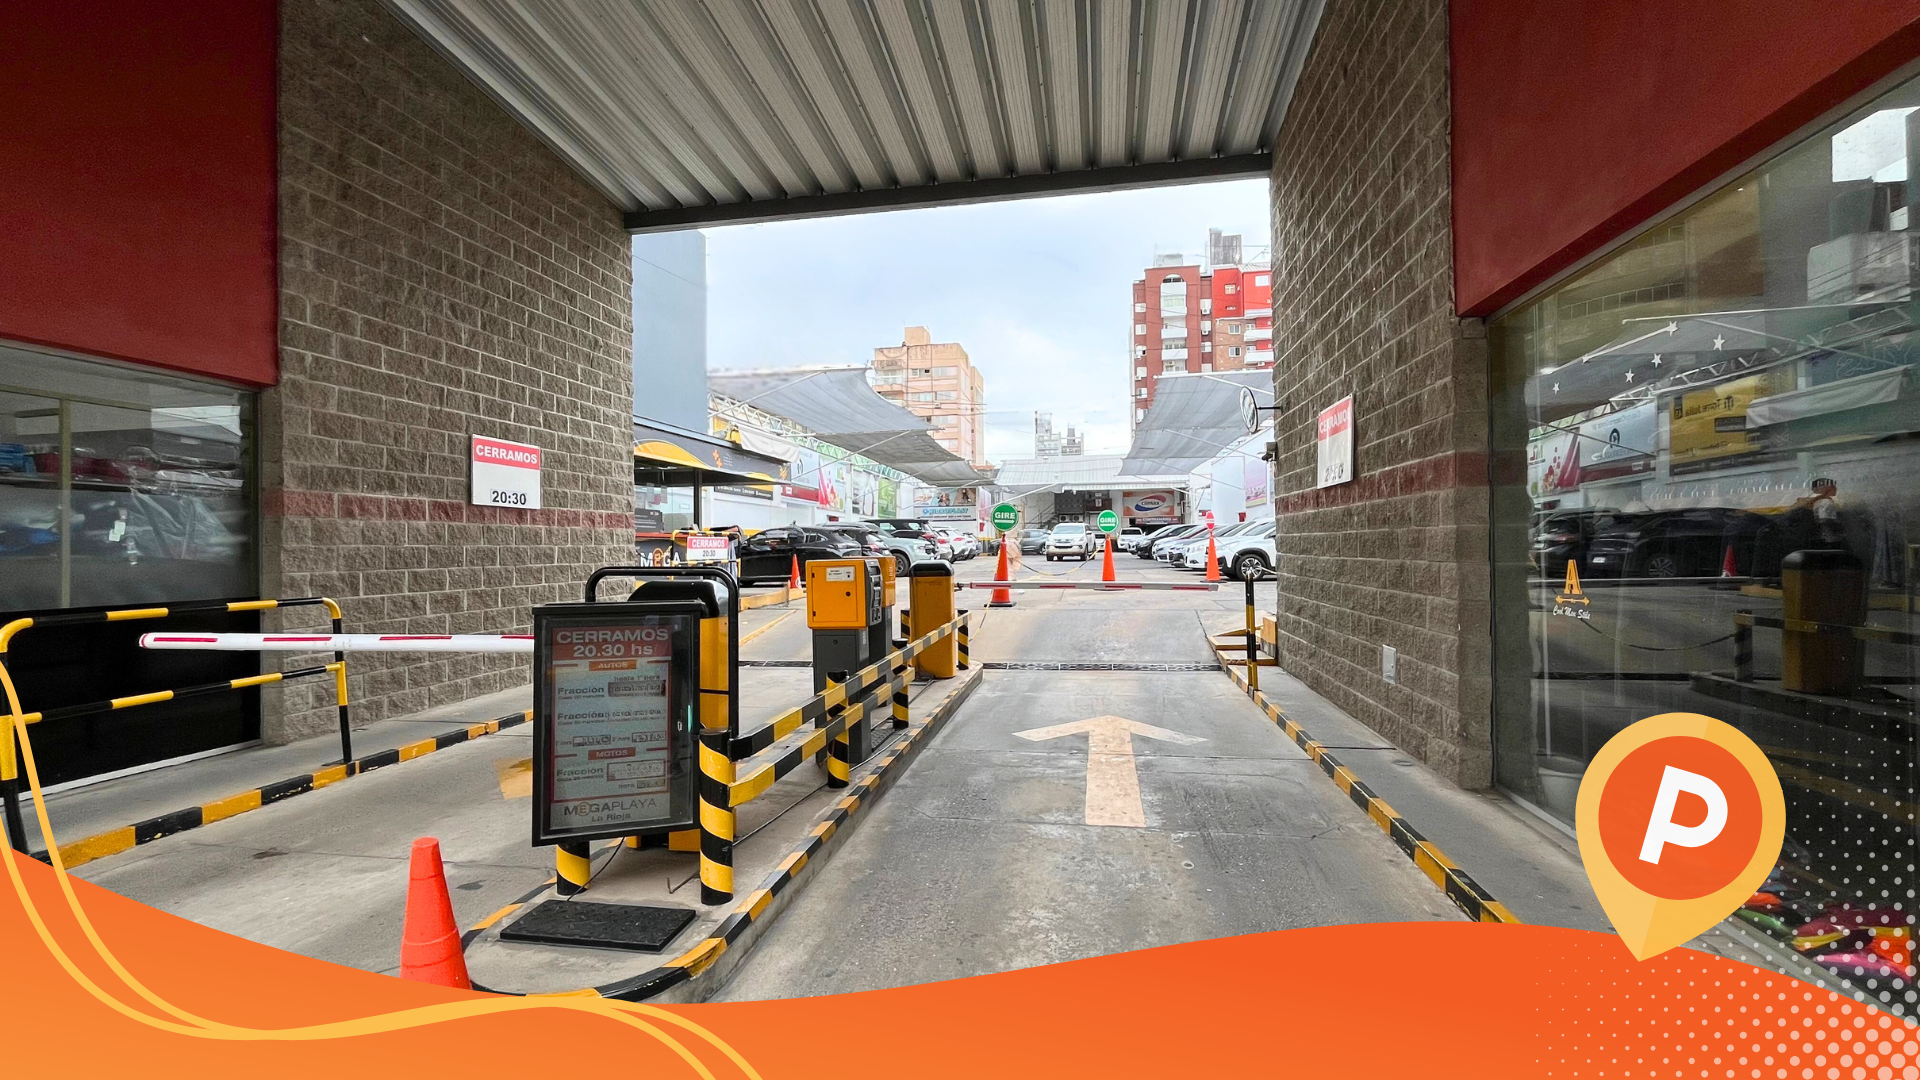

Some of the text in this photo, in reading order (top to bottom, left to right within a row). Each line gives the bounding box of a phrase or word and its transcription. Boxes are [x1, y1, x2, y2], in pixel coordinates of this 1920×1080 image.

[475, 444, 538, 465] CERRAMOS
[491, 490, 527, 505] 20:30
[994, 512, 1016, 520] GIRE
[691, 540, 726, 549] CERRAMOS
[556, 628, 669, 644] CERRAMOS
[573, 643, 653, 658] 20.30 hs
[598, 661, 629, 669] AUTOS
[557, 686, 604, 695] Fracción
[557, 711, 604, 720] Fracción
[595, 749, 629, 758] MOTOS
[557, 768, 604, 777] Fracción
[563, 798, 657, 816] MEGAPLAYA
[606, 813, 632, 821] Rioja
